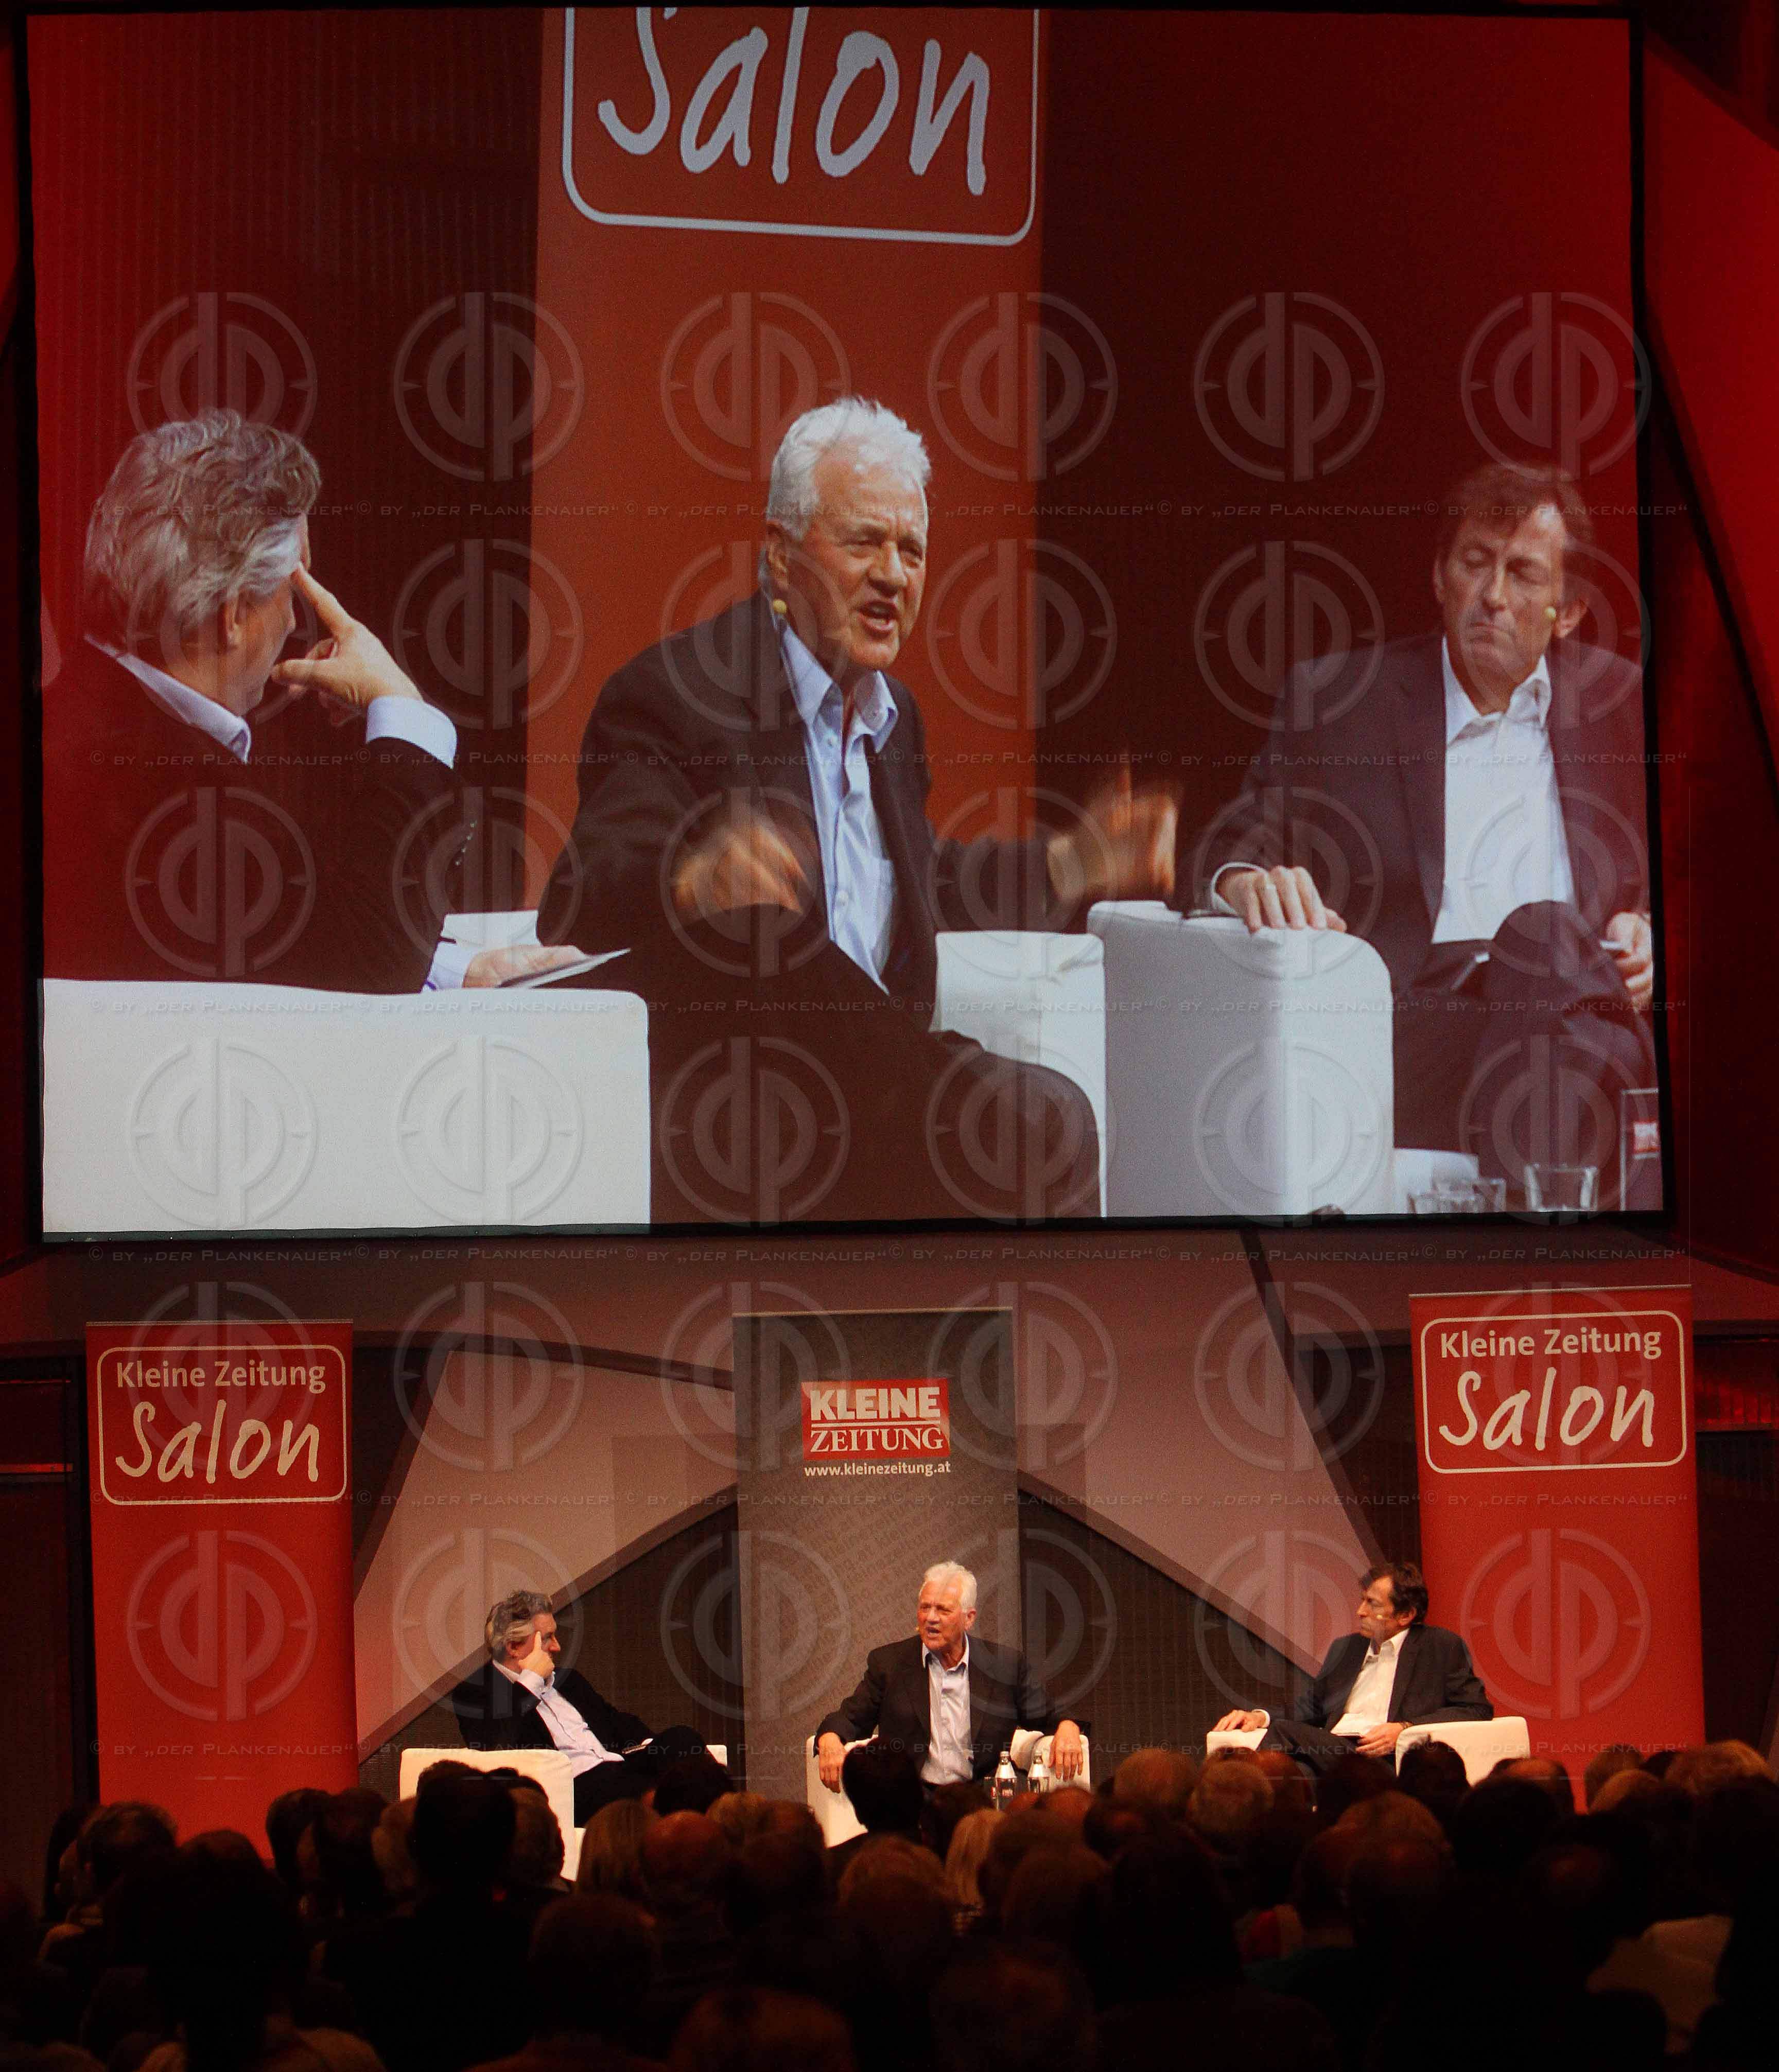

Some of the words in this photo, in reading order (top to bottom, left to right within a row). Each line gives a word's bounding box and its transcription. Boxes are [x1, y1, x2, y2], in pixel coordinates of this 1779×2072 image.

[1441, 1330, 1534, 1358] Kleine
[1544, 1327, 1662, 1360] Zeitung
[117, 1361, 205, 1387] Kleine
[215, 1360, 326, 1394] Zeitung
[811, 1387, 940, 1420] KLEINE
[1439, 1367, 1654, 1450] Salon
[115, 1399, 319, 1483] Salon
[810, 1427, 944, 1452] ZEITUNG
[804, 1462, 951, 1477] www.kleinezeitung.at
